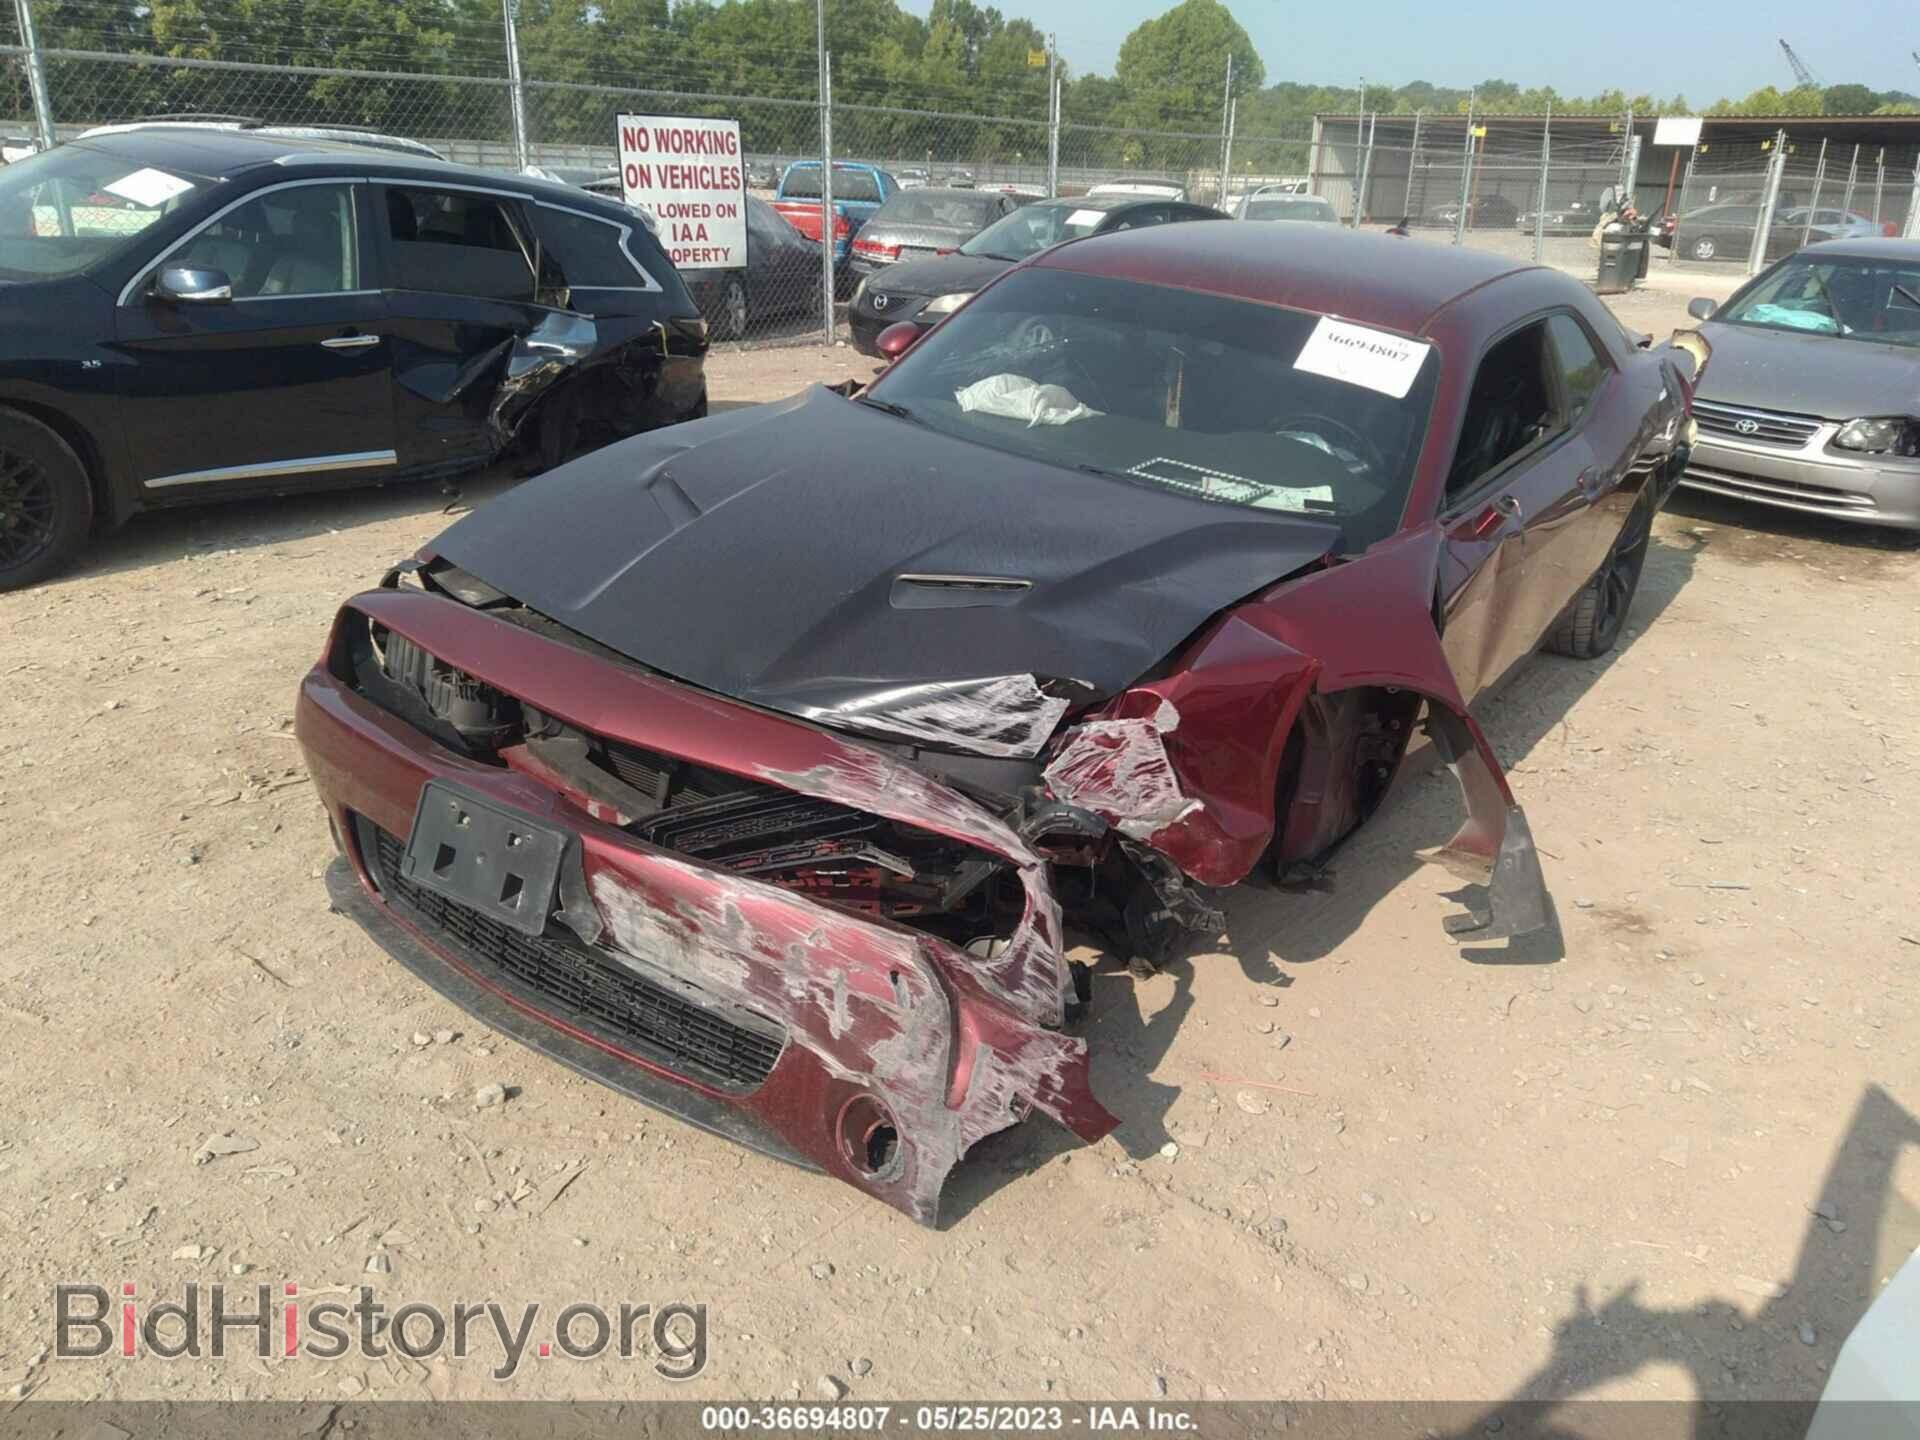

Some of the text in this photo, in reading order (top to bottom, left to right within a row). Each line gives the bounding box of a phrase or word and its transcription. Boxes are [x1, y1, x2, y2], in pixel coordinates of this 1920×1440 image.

[623, 127, 737, 155] NO WORKING
[625, 164, 741, 190] ON VEHICLES
[639, 203, 737, 218] LOWED ON
[672, 223, 709, 242] IAA
[664, 247, 730, 263] OPERTY
